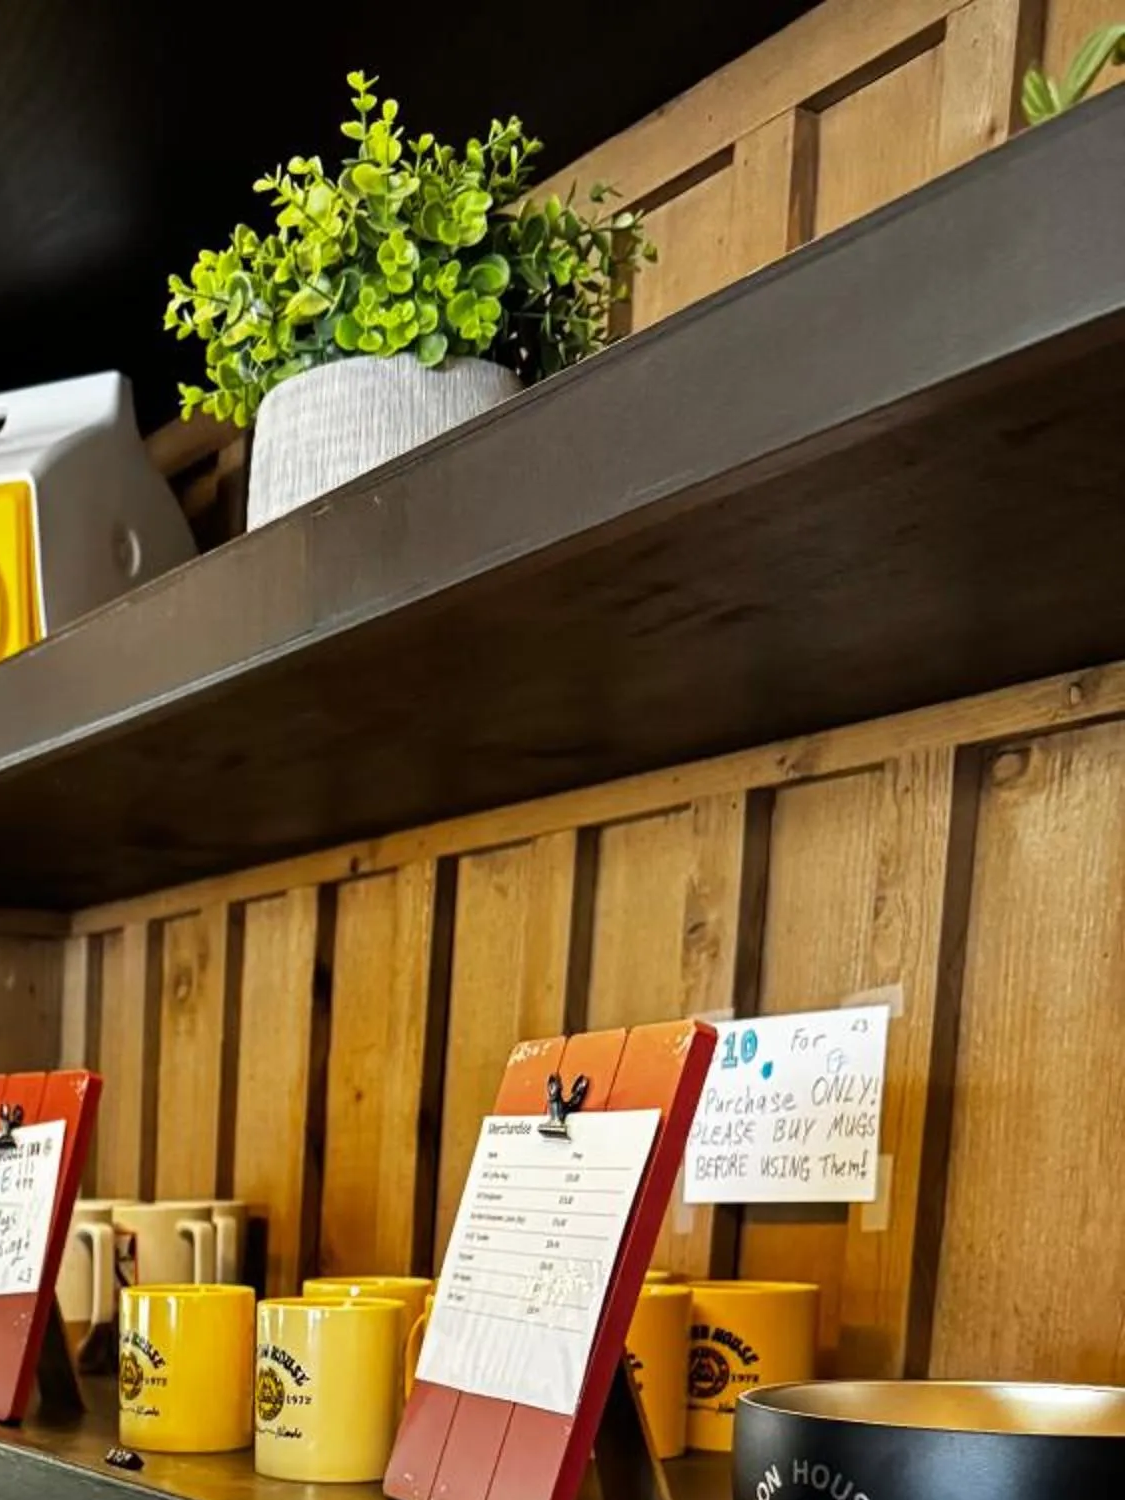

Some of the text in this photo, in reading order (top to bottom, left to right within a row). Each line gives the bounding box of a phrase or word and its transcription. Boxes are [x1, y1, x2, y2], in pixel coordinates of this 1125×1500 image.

[704, 1074, 879, 1116] Purchase ONLY!
[690, 1113, 875, 1147] PLEASE BUY MUGS
[695, 1153, 748, 1182] BEFORE
[761, 1155, 811, 1182] USING
